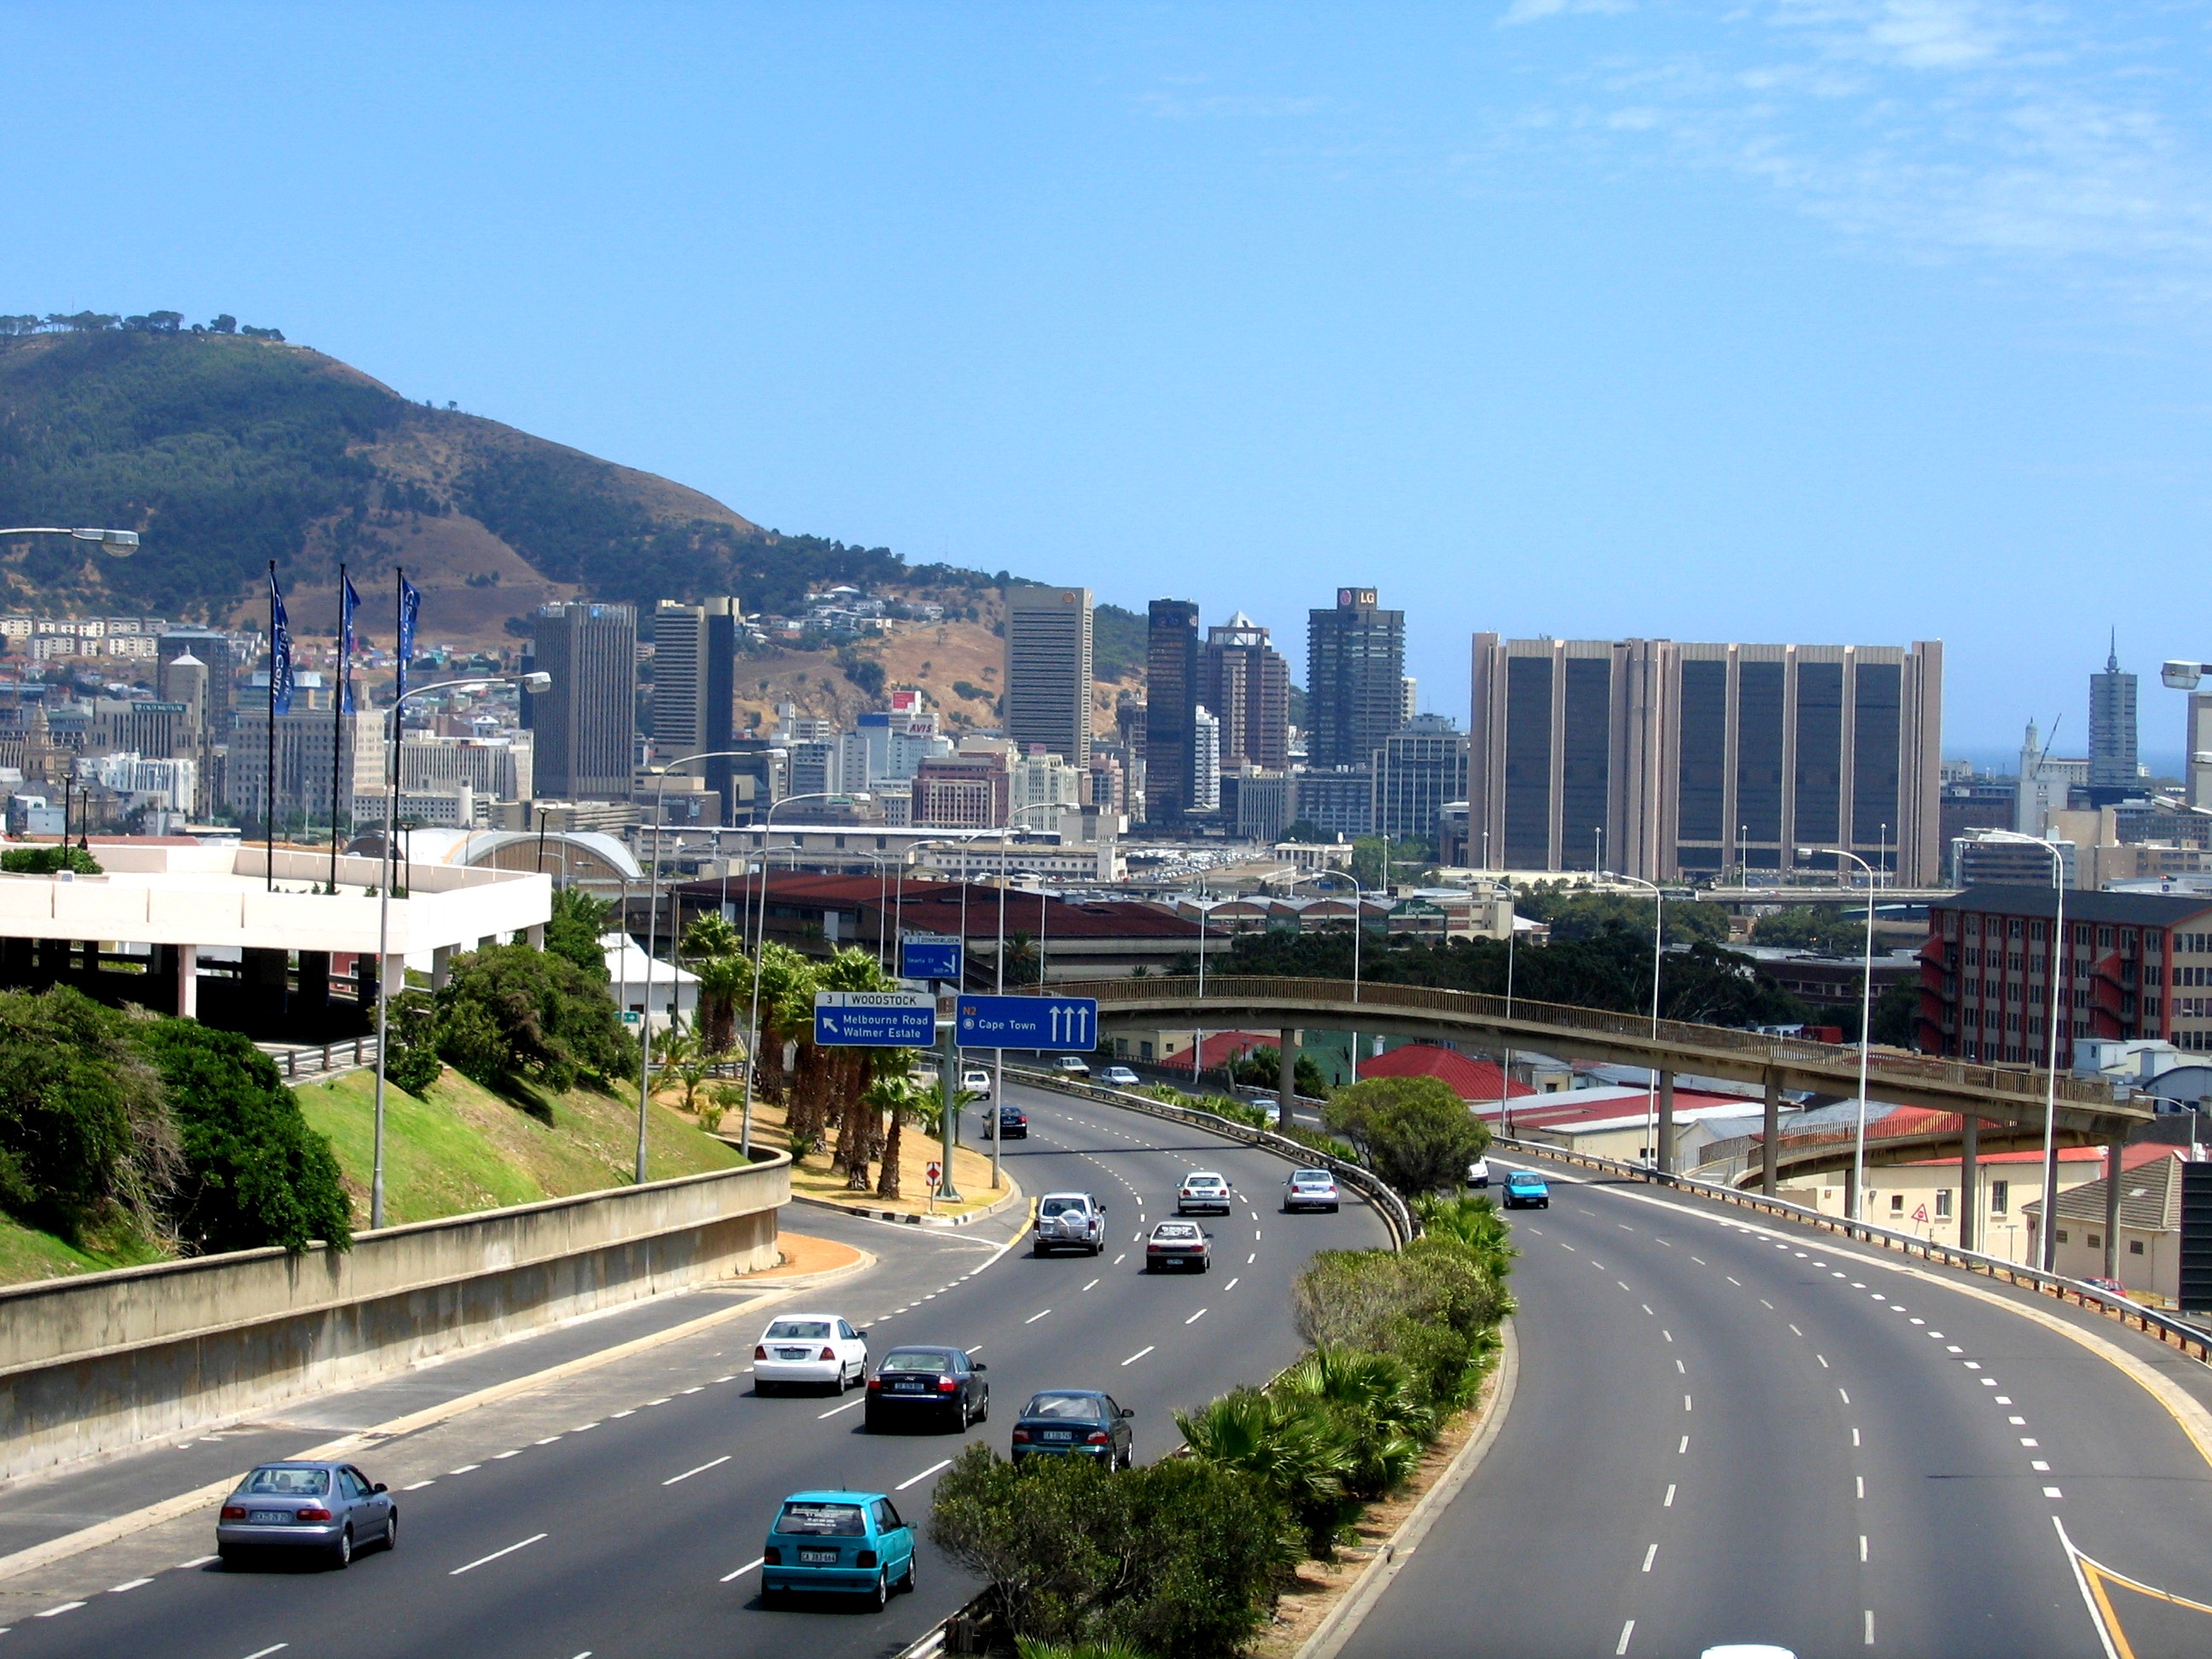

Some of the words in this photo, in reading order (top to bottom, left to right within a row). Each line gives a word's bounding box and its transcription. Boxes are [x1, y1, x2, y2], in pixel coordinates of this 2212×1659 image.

[1360, 591, 1375, 604] LG
[910, 724, 933, 733] AVIS
[827, 995, 833, 1004] 3
[852, 995, 917, 1005] WOODSTOCK
[963, 1006, 977, 1016] N2
[843, 1015, 898, 1025] Melbourne
[902, 1015, 928, 1025] Road
[979, 1019, 1004, 1032] Cape
[1009, 1020, 1036, 1030] Town
[843, 1027, 884, 1038] Walmer
[888, 1027, 921, 1039] Estate
